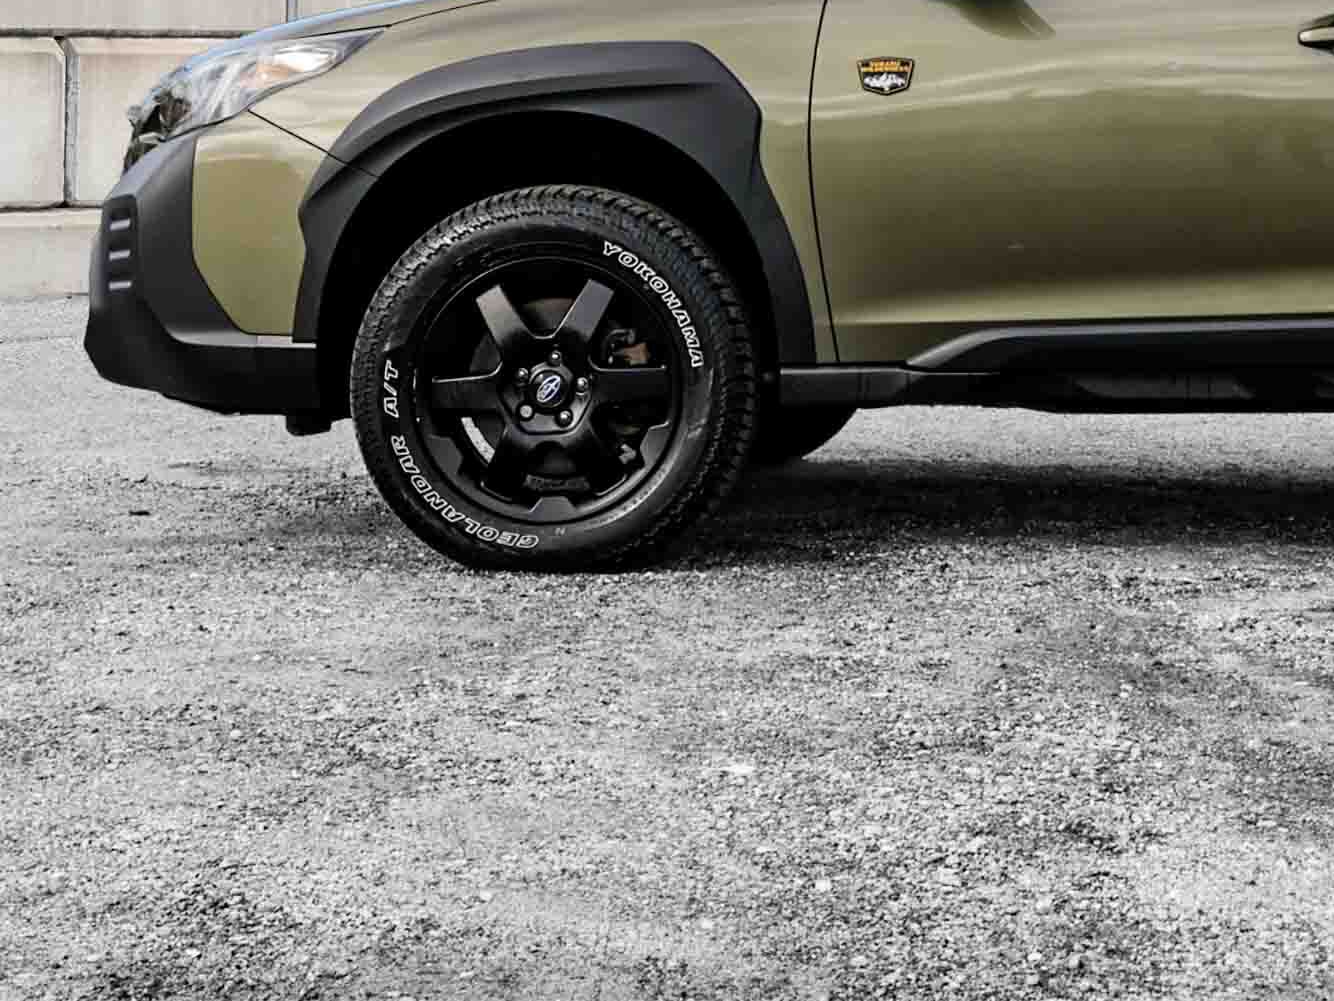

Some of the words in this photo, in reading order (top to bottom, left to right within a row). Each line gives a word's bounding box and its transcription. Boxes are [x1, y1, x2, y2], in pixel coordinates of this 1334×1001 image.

[601, 240, 704, 368] YOKOHAMA
[383, 360, 400, 418] A/T
[390, 434, 540, 549] GEOLANDAR
